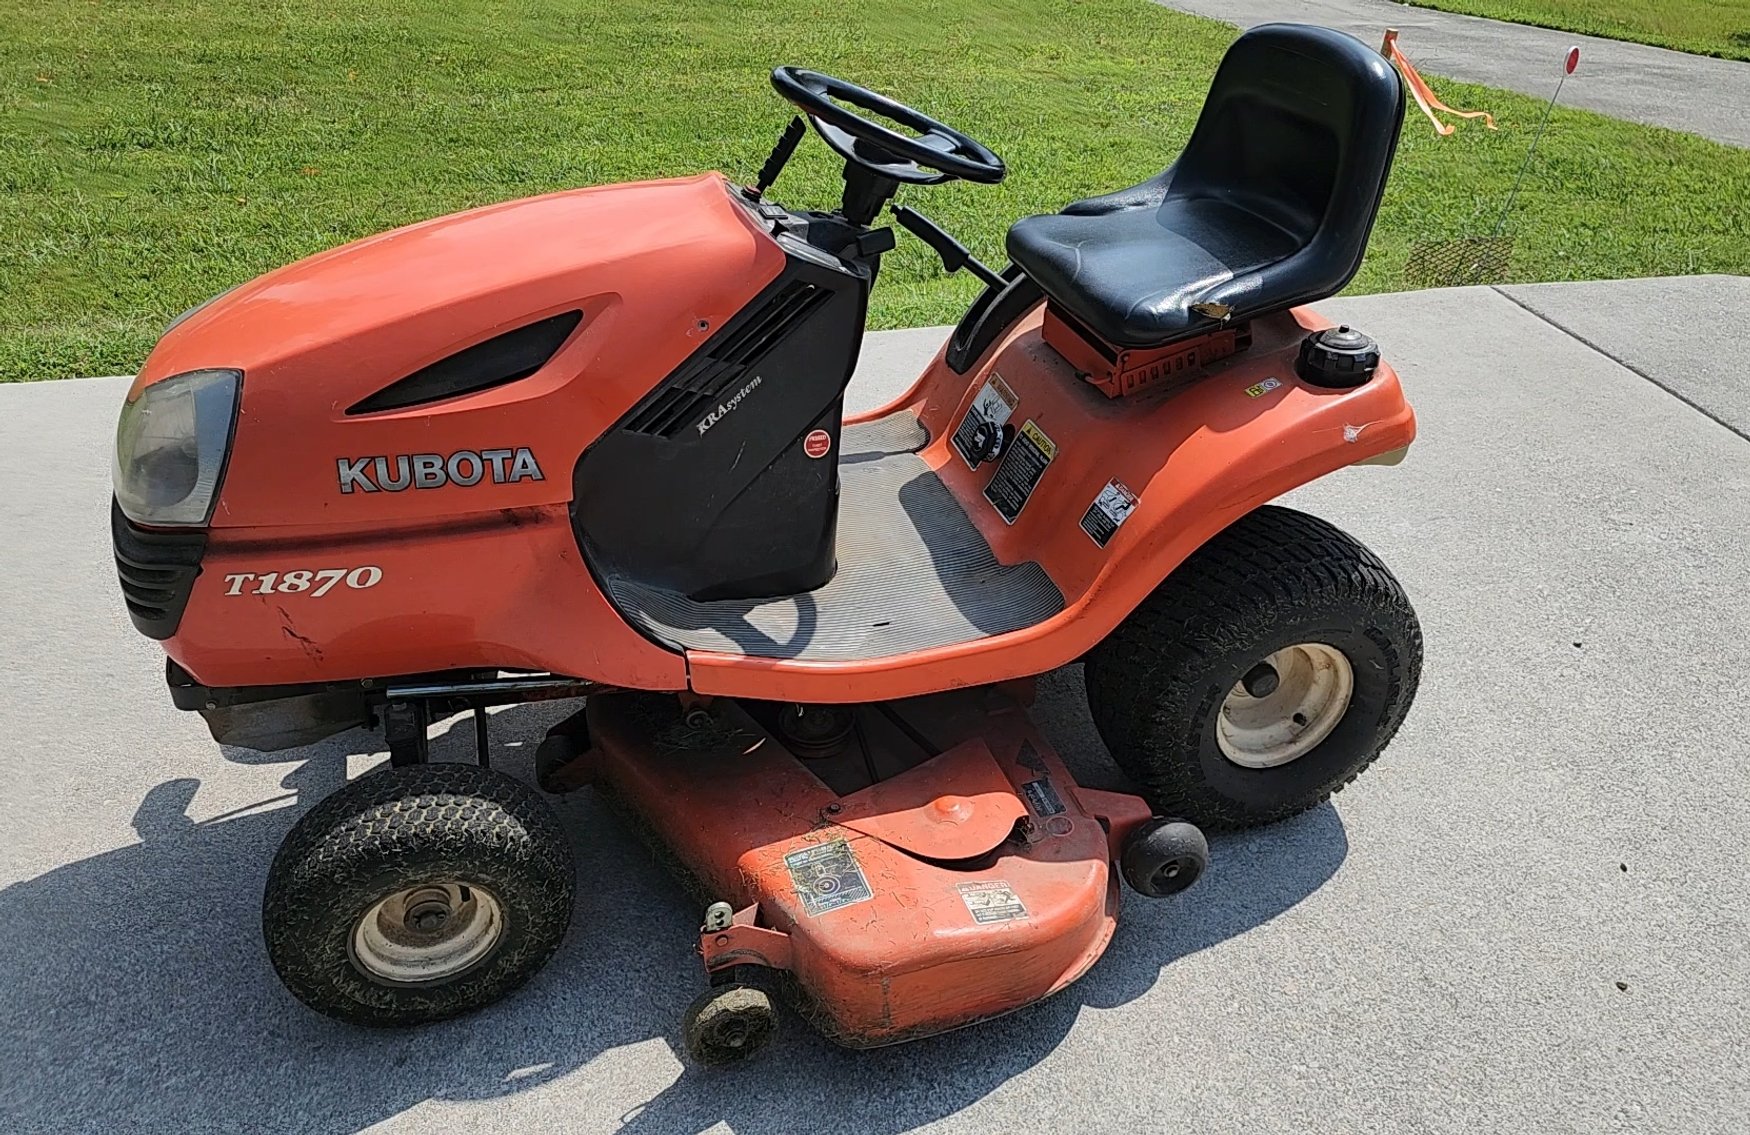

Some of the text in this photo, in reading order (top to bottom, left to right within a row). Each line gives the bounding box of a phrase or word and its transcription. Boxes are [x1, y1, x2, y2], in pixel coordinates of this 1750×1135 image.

[1032, 433, 1052, 455] CAUTION
[336, 448, 545, 493] KUBOTA
[224, 566, 383, 597] T1870
